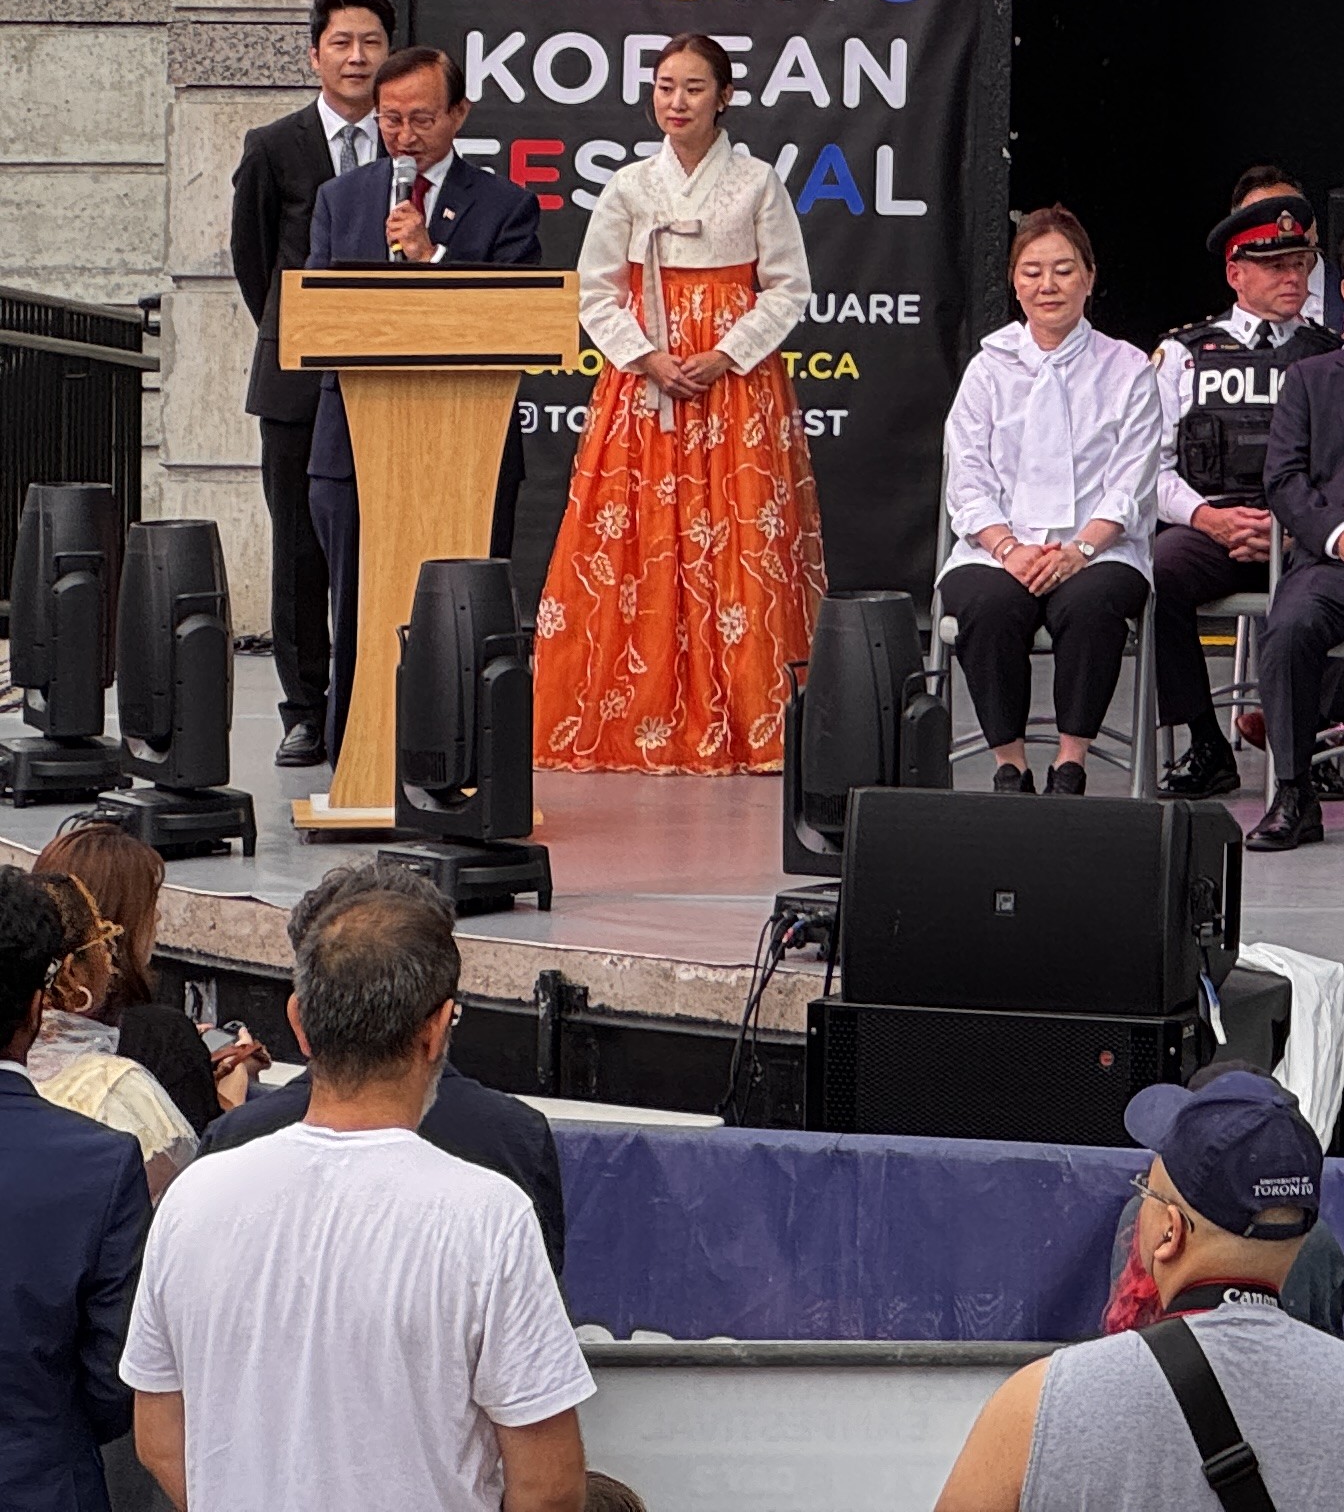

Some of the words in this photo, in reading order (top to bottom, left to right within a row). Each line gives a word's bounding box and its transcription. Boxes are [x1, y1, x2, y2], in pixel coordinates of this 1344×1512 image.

[798, 292, 921, 325] UARE
[1198, 366, 1287, 406] POLI
[1252, 1183, 1314, 1197] TORONTO
